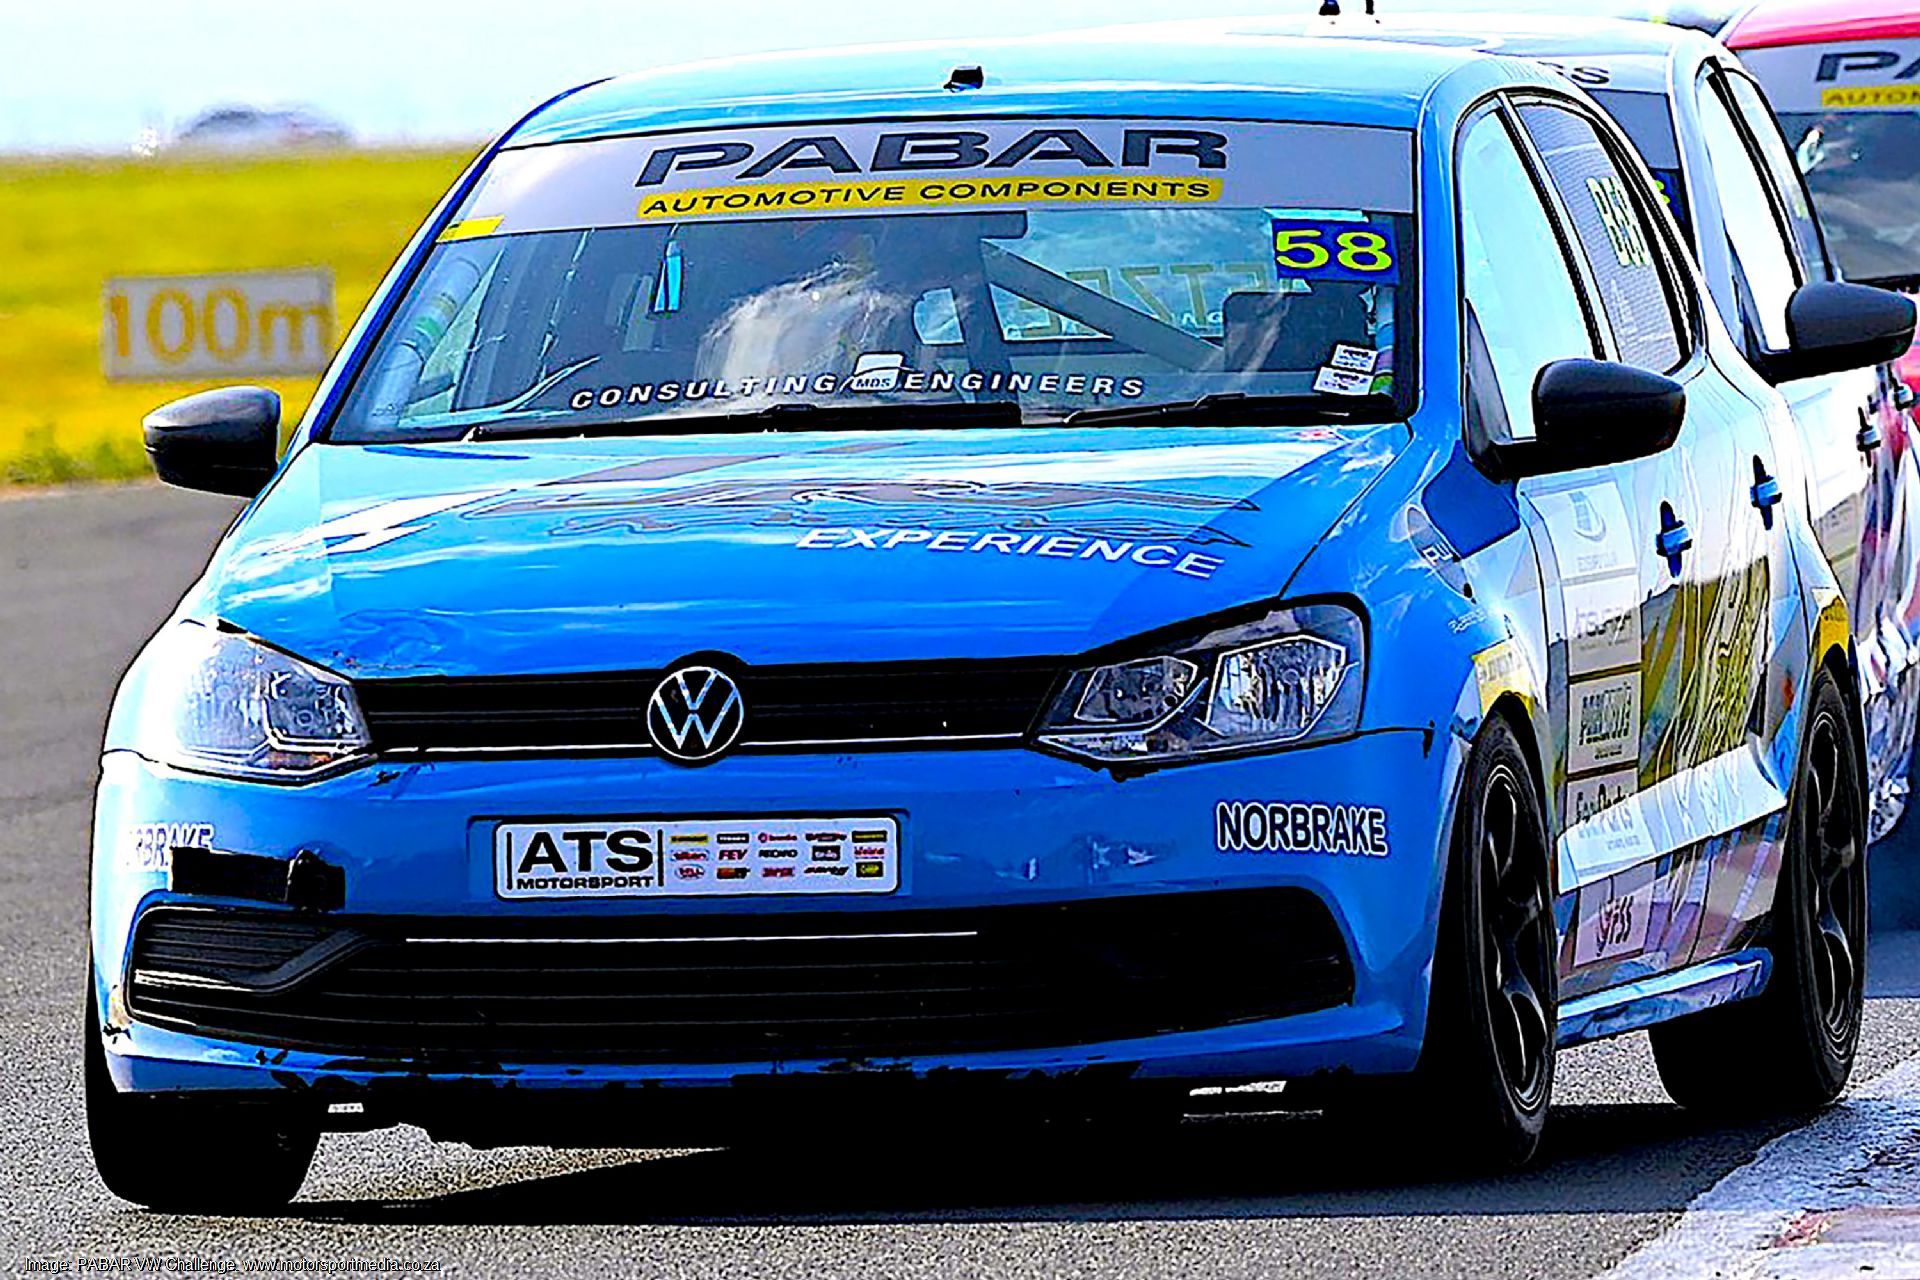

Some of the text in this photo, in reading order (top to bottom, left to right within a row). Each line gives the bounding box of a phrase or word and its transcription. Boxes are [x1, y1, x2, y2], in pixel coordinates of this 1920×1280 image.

[634, 128, 1228, 187] PABAR
[643, 179, 1212, 215] AUTOMOTIVE COMPONENTS
[1275, 229, 1393, 272] 58
[110, 288, 331, 364] 100m
[571, 374, 837, 409] CONSULTING
[903, 373, 1146, 397] ENGINEERS
[796, 527, 1226, 579] EXPERIENCE
[517, 829, 654, 874] ATS
[1215, 801, 1389, 857] NORBRAKE
[517, 875, 654, 890] MOTORSPORT
